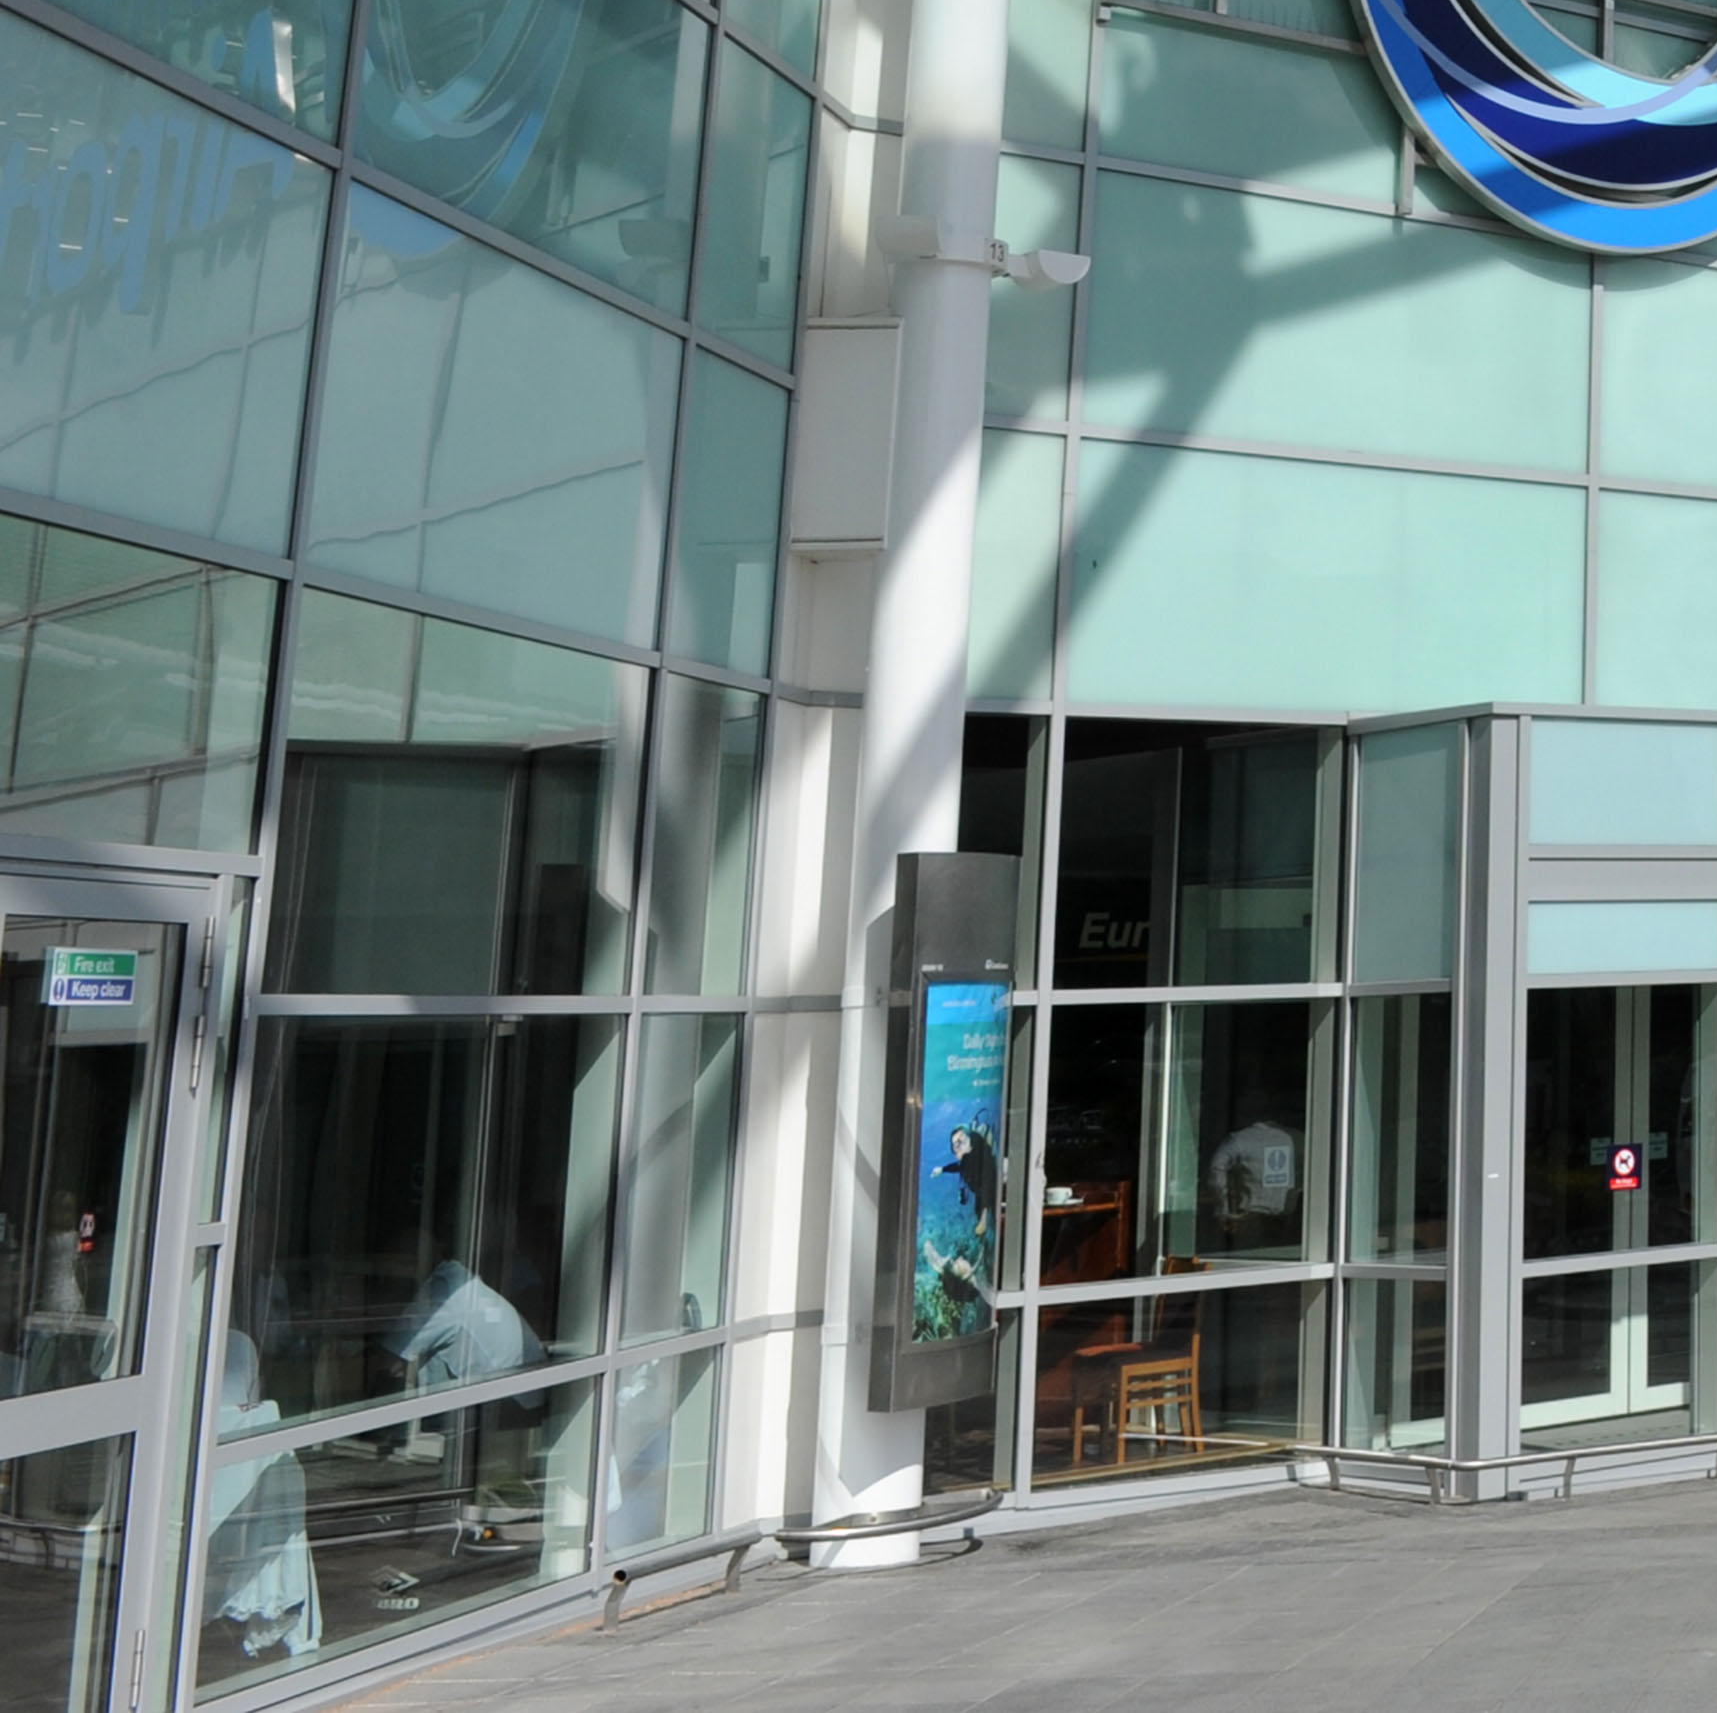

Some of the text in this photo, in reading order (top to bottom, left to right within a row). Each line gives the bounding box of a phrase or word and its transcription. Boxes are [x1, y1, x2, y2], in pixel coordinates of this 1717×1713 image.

[74, 955, 115, 974] Fire exit
[71, 980, 126, 1001] Keep clear
